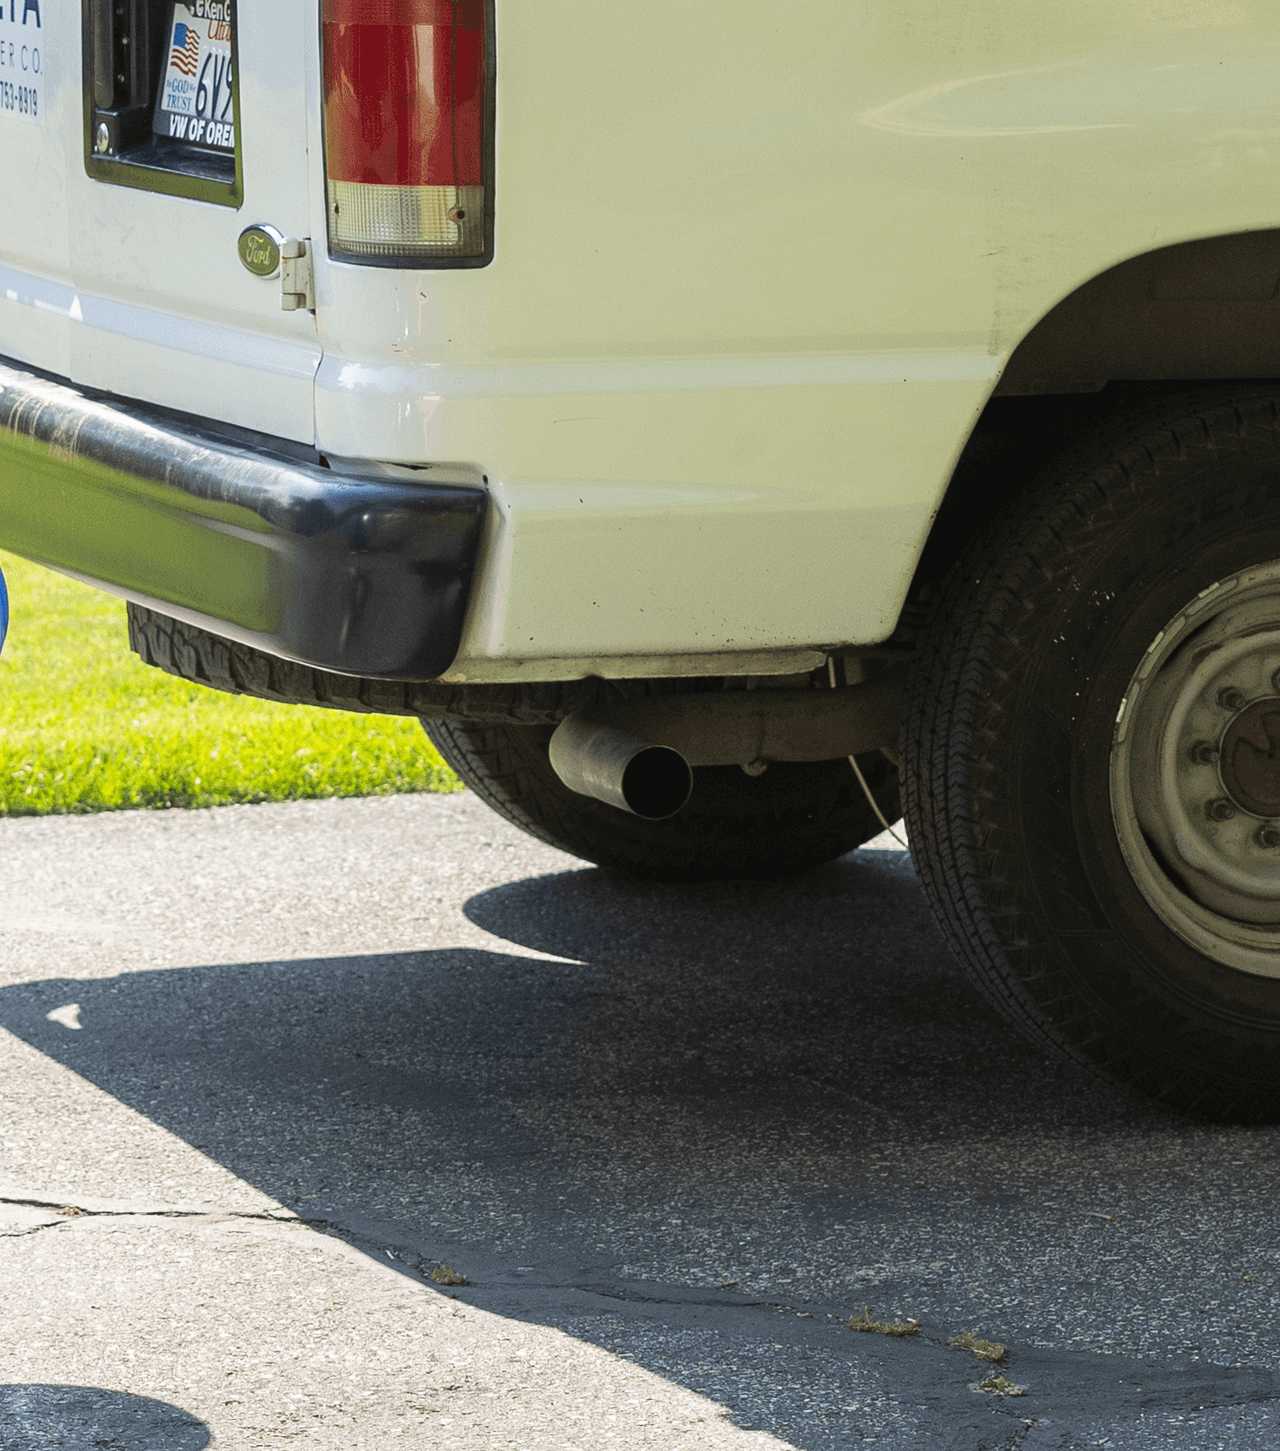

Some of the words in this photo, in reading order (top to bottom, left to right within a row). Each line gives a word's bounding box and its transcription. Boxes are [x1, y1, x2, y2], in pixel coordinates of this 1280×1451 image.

[0, 80, 37, 116] 753-8919
[172, 78, 189, 94] GOD
[167, 94, 192, 111] TRUST
[170, 114, 189, 139] VW
[189, 118, 206, 142] OF
[246, 235, 271, 265] Ford
